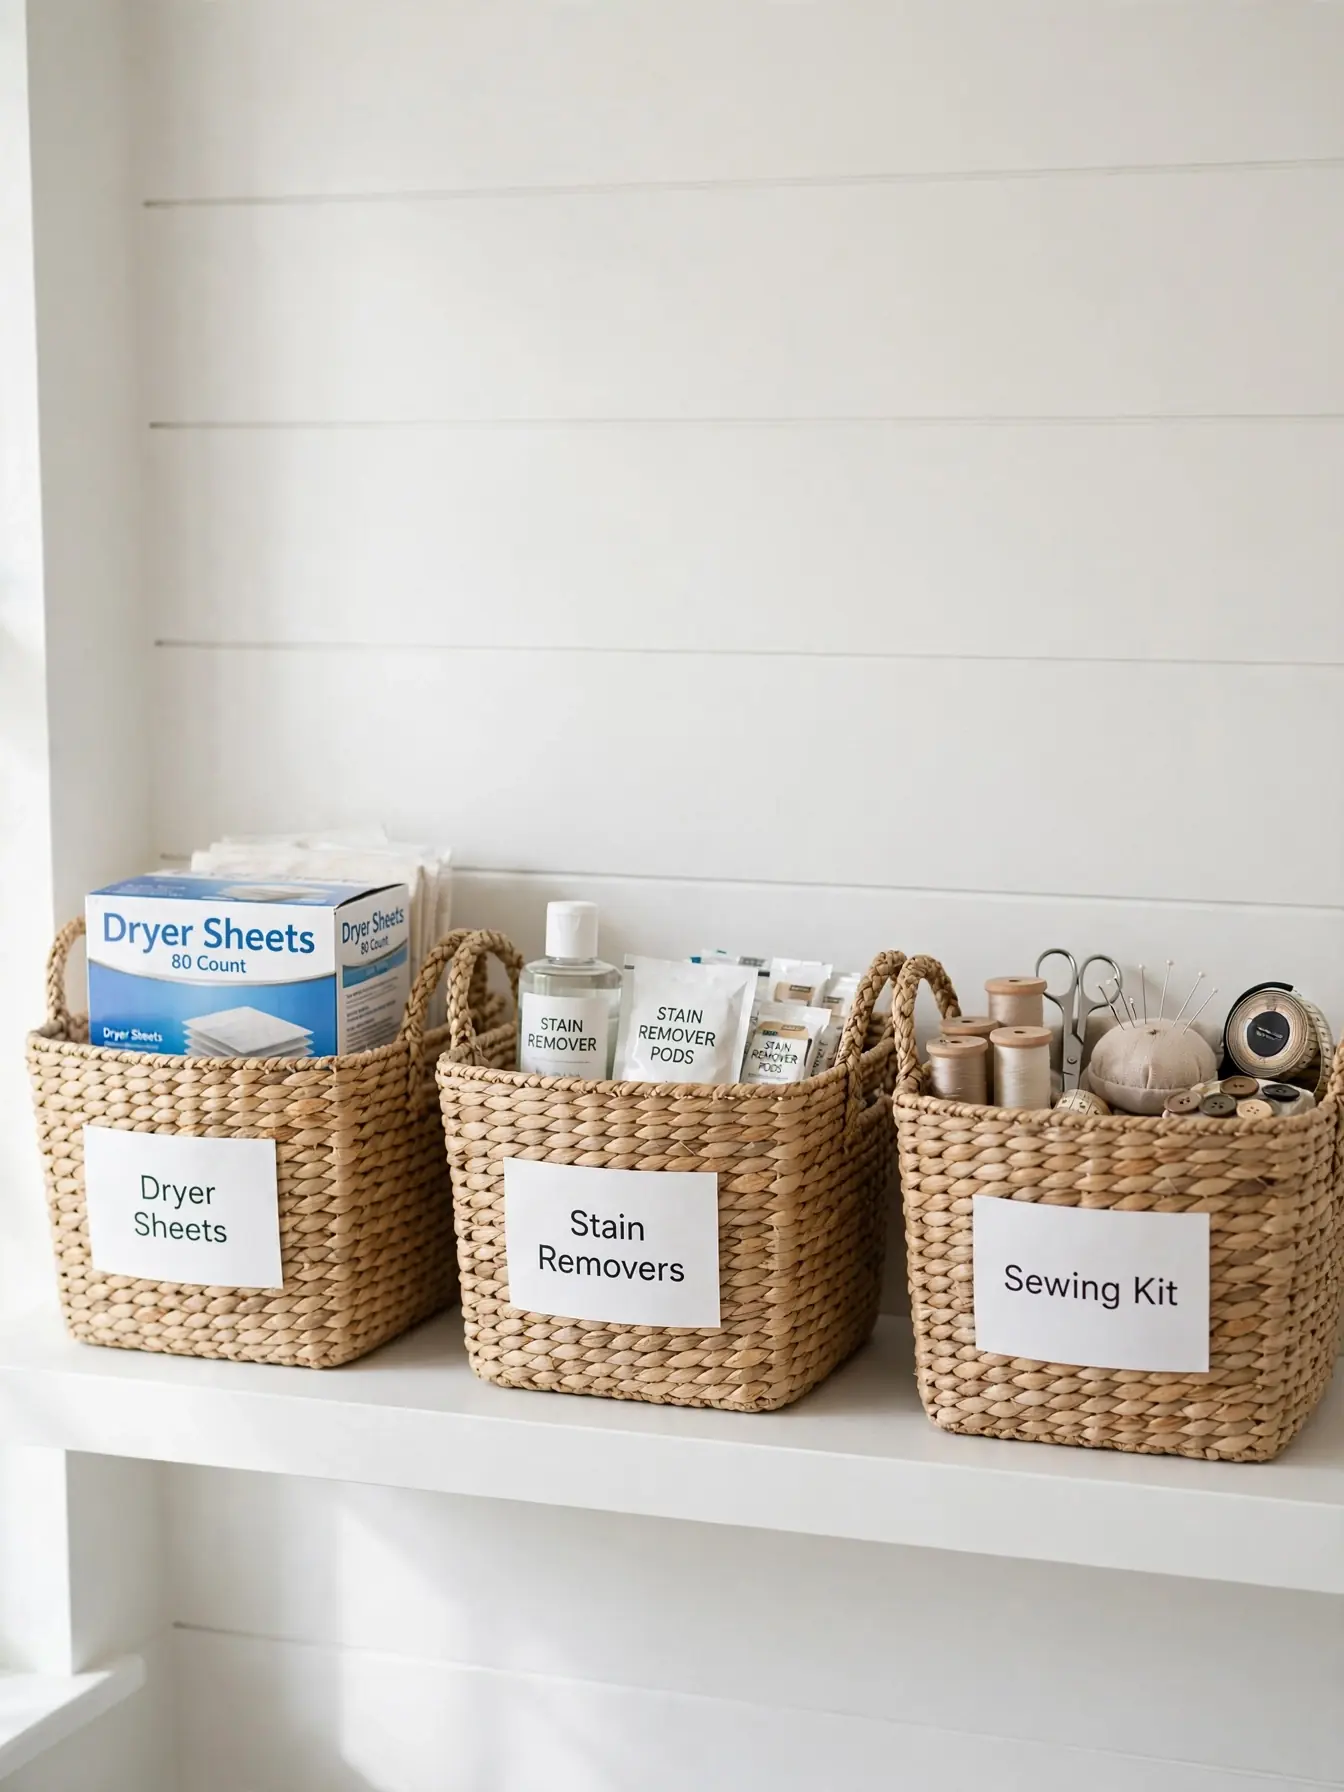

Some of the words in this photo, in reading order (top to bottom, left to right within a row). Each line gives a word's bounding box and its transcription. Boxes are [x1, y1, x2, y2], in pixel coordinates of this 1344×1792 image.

[103, 912, 194, 954] Dryer
[203, 917, 315, 954] Sheets
[342, 921, 370, 945] Dryer
[372, 907, 405, 933] Sheets
[370, 935, 390, 951] Count
[171, 953, 192, 970] 80
[196, 955, 247, 974] Count
[540, 1017, 584, 1033] STAIN
[656, 1006, 704, 1024] STAIN
[103, 1027, 129, 1042] Dryer
[130, 1028, 163, 1043] Sheets
[527, 1033, 597, 1052] REMOVER
[639, 1024, 716, 1048] REMOVER
[650, 1046, 695, 1065] PODS
[764, 1040, 792, 1052] STAIN
[751, 1048, 798, 1065] REMOVER
[758, 1062, 782, 1074] PODS
[141, 1174, 216, 1210] Dryer
[134, 1211, 228, 1244] Sheets
[570, 1209, 645, 1242] Stain
[539, 1243, 685, 1283] Removers
[1004, 1264, 1120, 1310] Sewing
[1134, 1276, 1178, 1307] Kit
